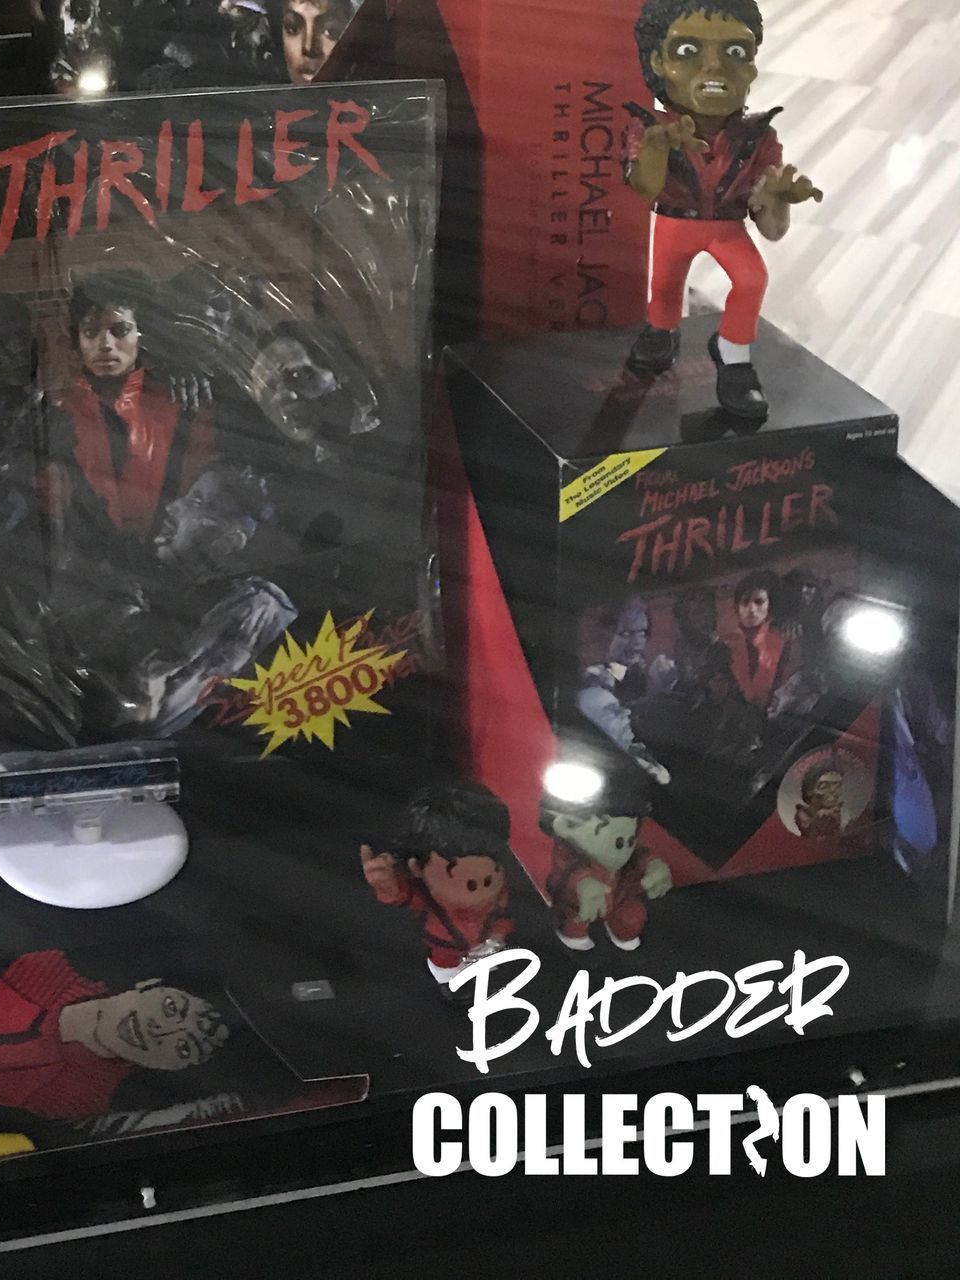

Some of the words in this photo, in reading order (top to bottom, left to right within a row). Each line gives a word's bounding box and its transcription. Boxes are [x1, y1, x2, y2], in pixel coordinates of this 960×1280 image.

[549, 82, 572, 245] THRILLER
[577, 80, 614, 245] MICHAEL
[582, 465, 607, 484] From
[639, 478, 720, 517] MICHAEL
[615, 483, 839, 584] THRILLER
